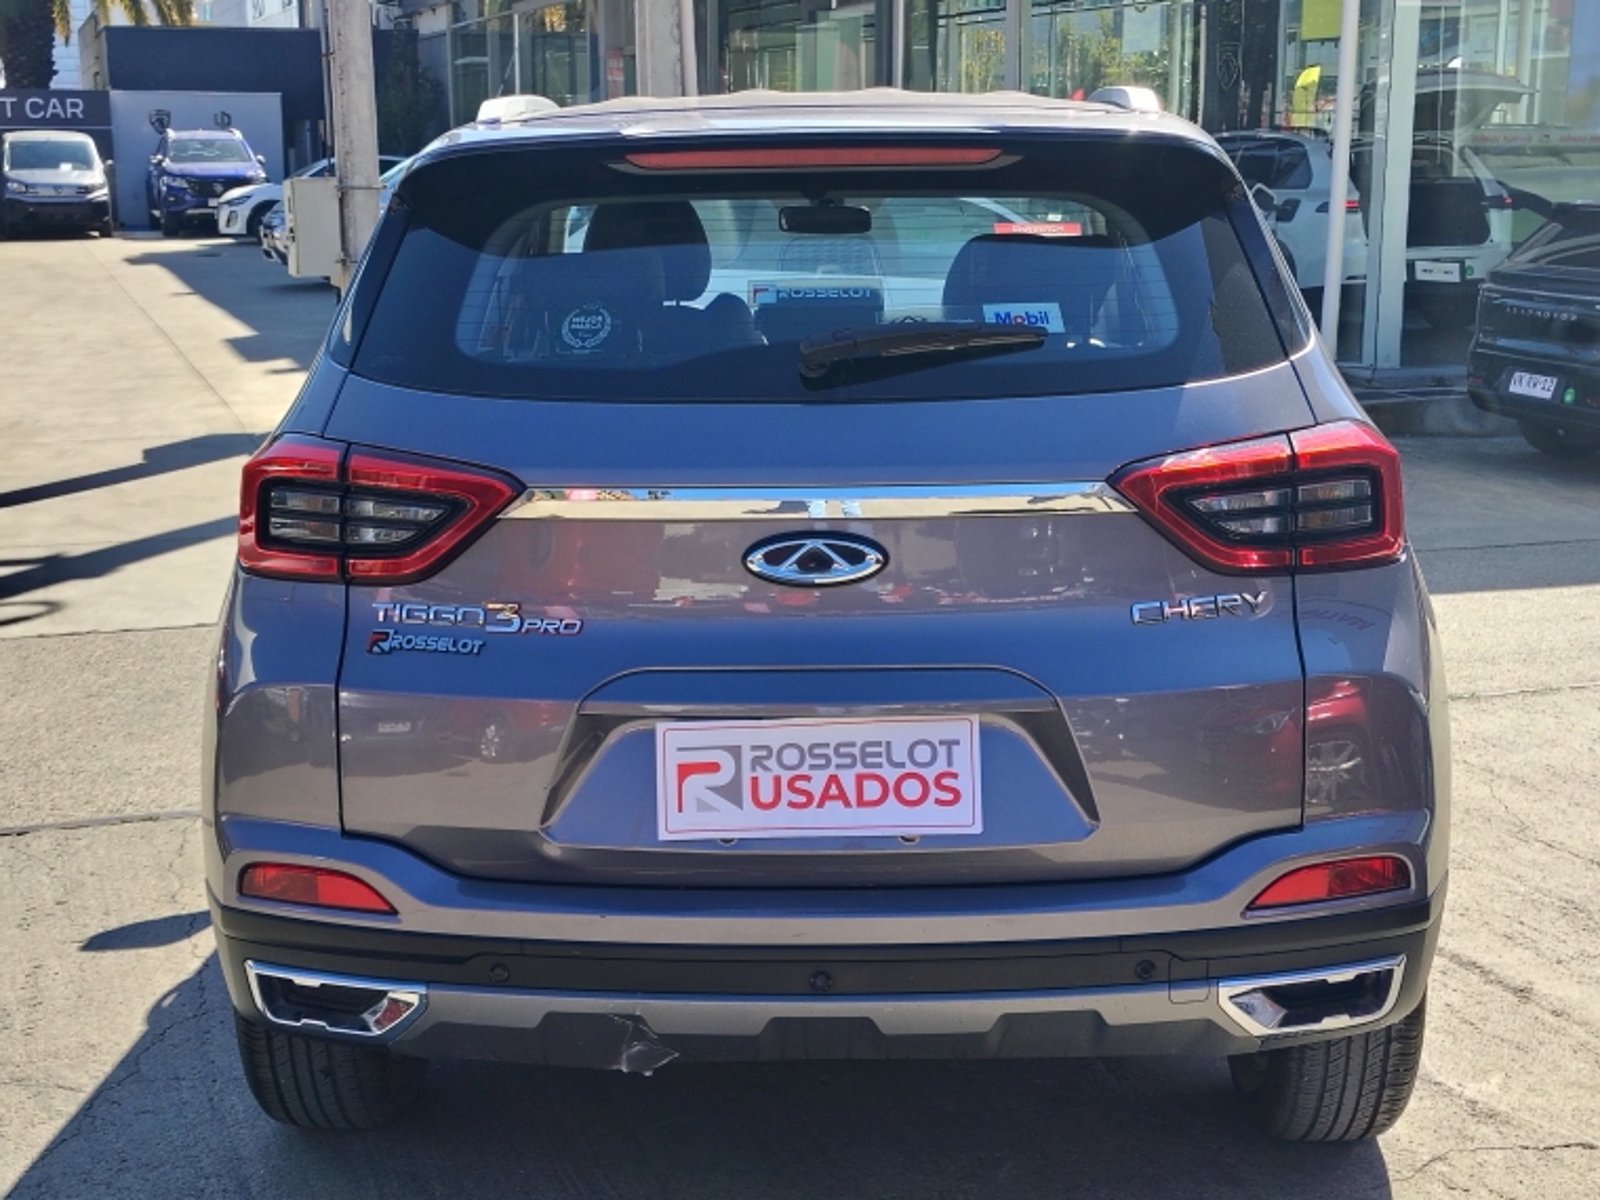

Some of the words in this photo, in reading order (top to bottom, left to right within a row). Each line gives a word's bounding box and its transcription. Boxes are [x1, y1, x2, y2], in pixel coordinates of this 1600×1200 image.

[25, 97, 84, 119] CAR
[994, 310, 1050, 326] Mobil
[1130, 590, 1268, 625] CHERY
[521, 618, 583, 634] PRO
[389, 633, 485, 655] ROSSELOT
[749, 738, 961, 773] ROSSELOT
[749, 770, 962, 811] USADOS
